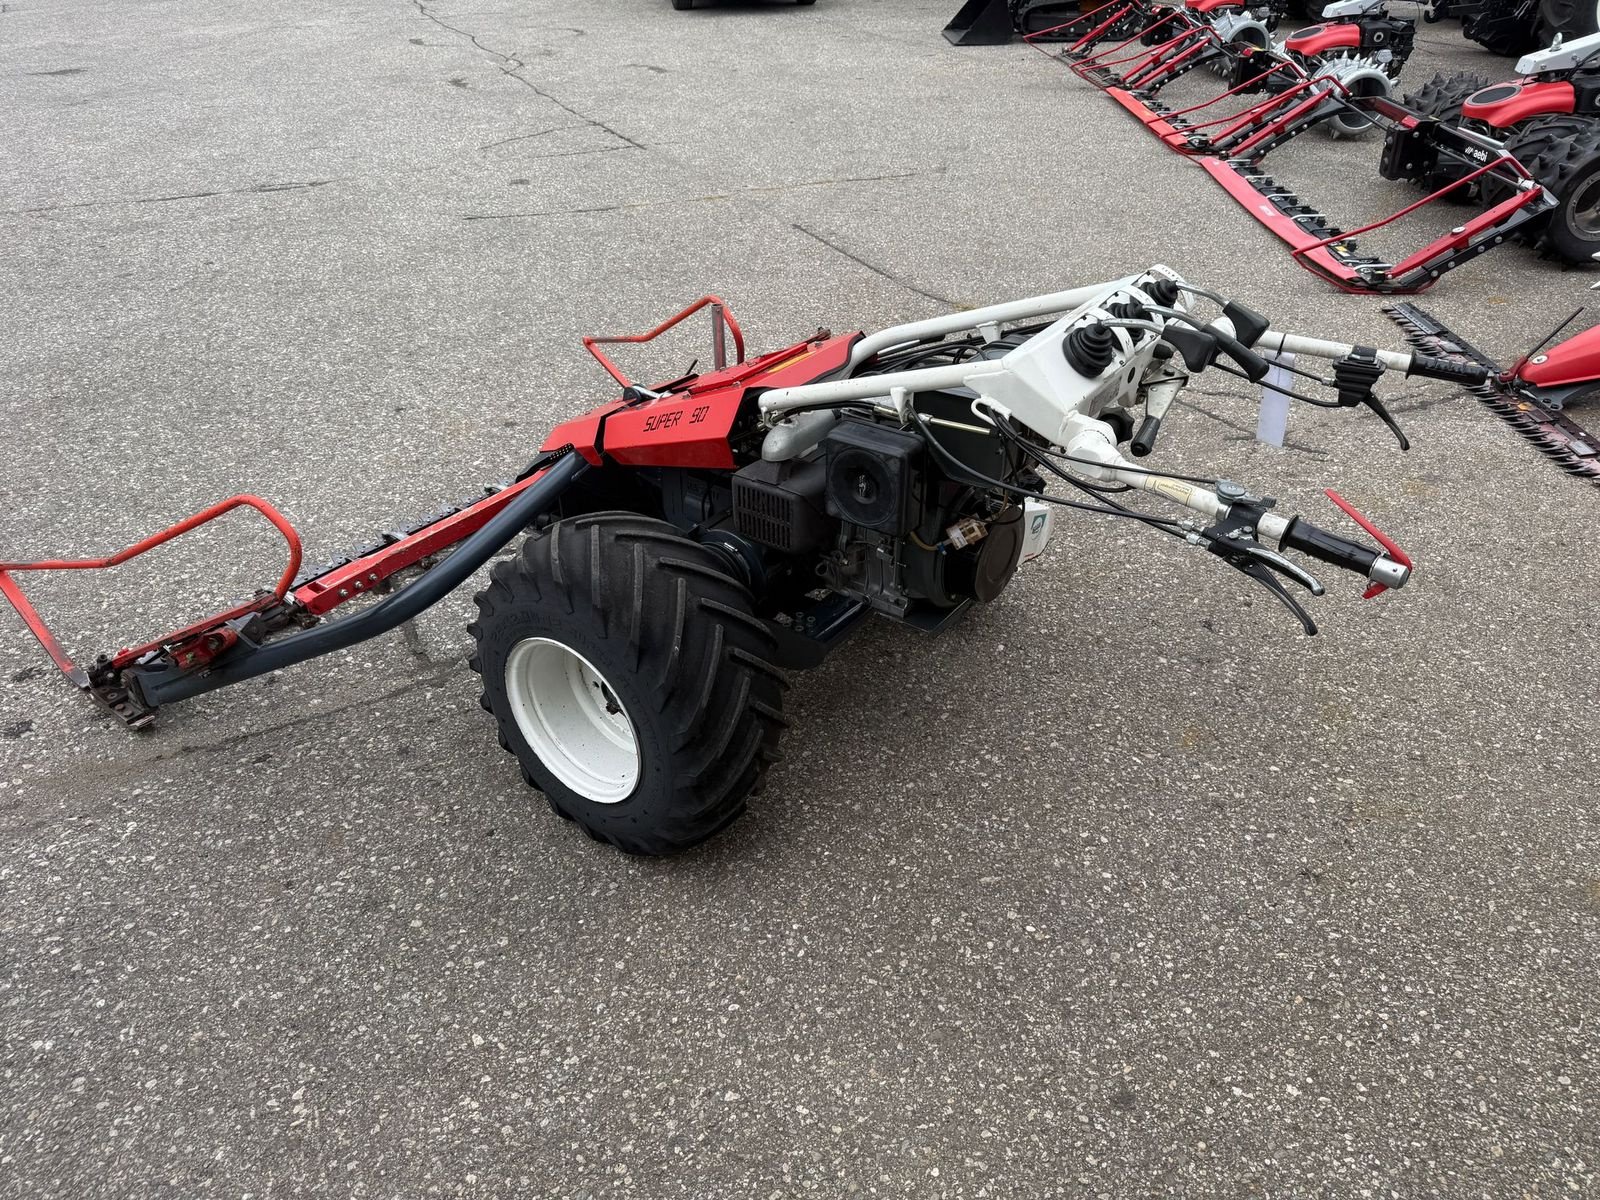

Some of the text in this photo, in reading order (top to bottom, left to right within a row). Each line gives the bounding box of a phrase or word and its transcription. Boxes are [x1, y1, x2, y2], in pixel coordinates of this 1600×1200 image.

[1473, 149, 1488, 162] aebi
[643, 405, 710, 432] SUPER 90
